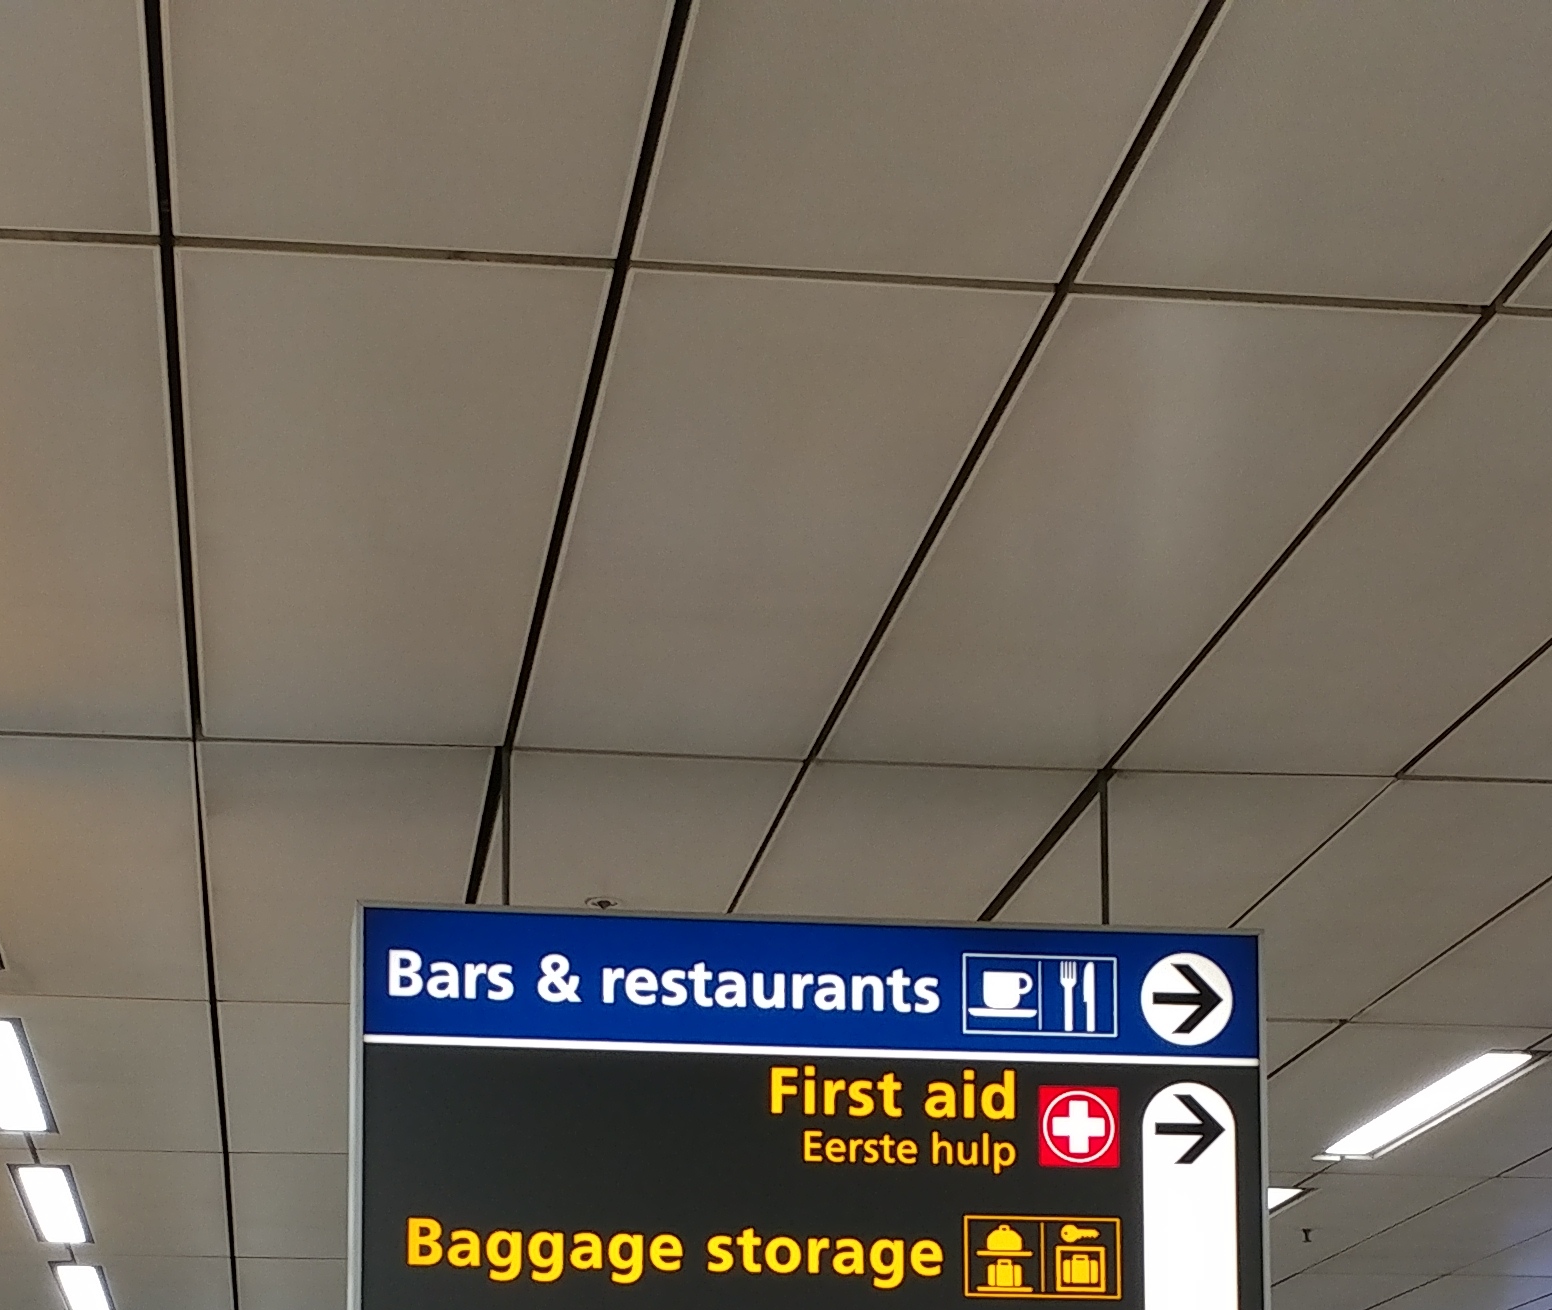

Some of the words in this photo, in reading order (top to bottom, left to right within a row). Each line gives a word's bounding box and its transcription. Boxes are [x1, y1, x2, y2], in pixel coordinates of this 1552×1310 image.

[387, 949, 514, 1001] Bars
[538, 953, 582, 1003] &
[601, 962, 941, 1014] restaurants
[770, 1065, 902, 1118] First
[924, 1069, 1016, 1120] aid
[803, 1130, 919, 1165] Eerste
[932, 1131, 1017, 1174] hulp
[406, 1216, 684, 1285] Baggage
[706, 1227, 944, 1289] storage
